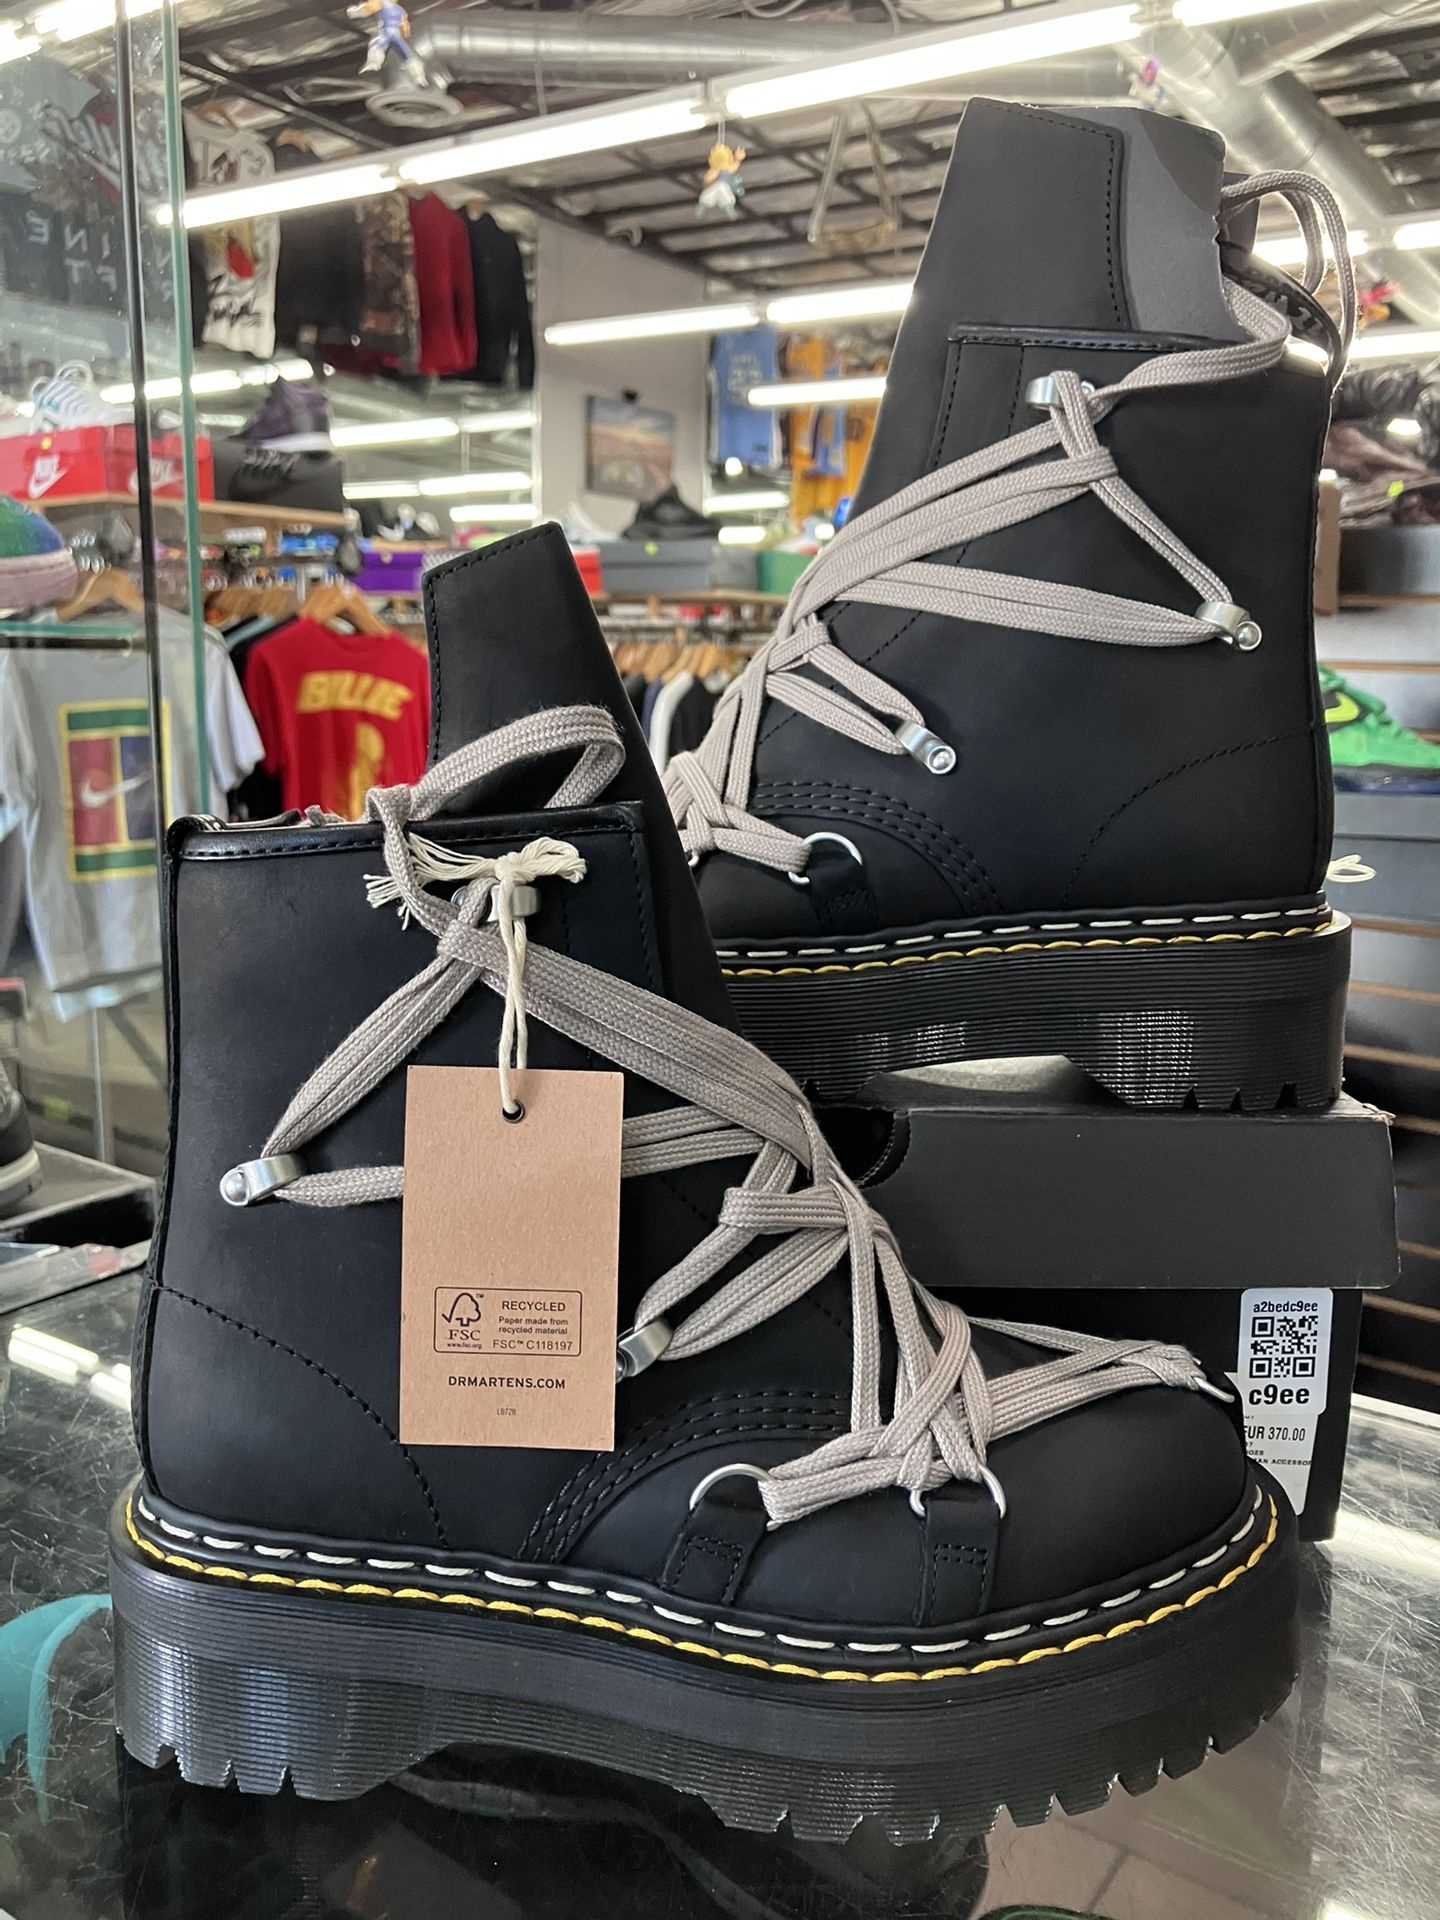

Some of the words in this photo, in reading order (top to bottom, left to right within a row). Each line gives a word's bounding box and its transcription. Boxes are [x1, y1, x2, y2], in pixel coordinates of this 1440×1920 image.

[501, 1300, 566, 1312] RECYCLED
[1252, 1300, 1319, 1313] a2bedc9ee
[498, 1316, 523, 1326] Paper
[525, 1317, 548, 1325] made
[550, 1317, 569, 1326] from
[448, 1329, 481, 1341] FSC
[498, 1326, 533, 1336] recycled
[535, 1327, 568, 1335] material
[526, 1340, 573, 1351] C118197
[448, 1376, 566, 1390] DRMARTENS.COM
[1248, 1384, 1310, 1406] c9ee
[1268, 1426, 1306, 1441] 370.00
